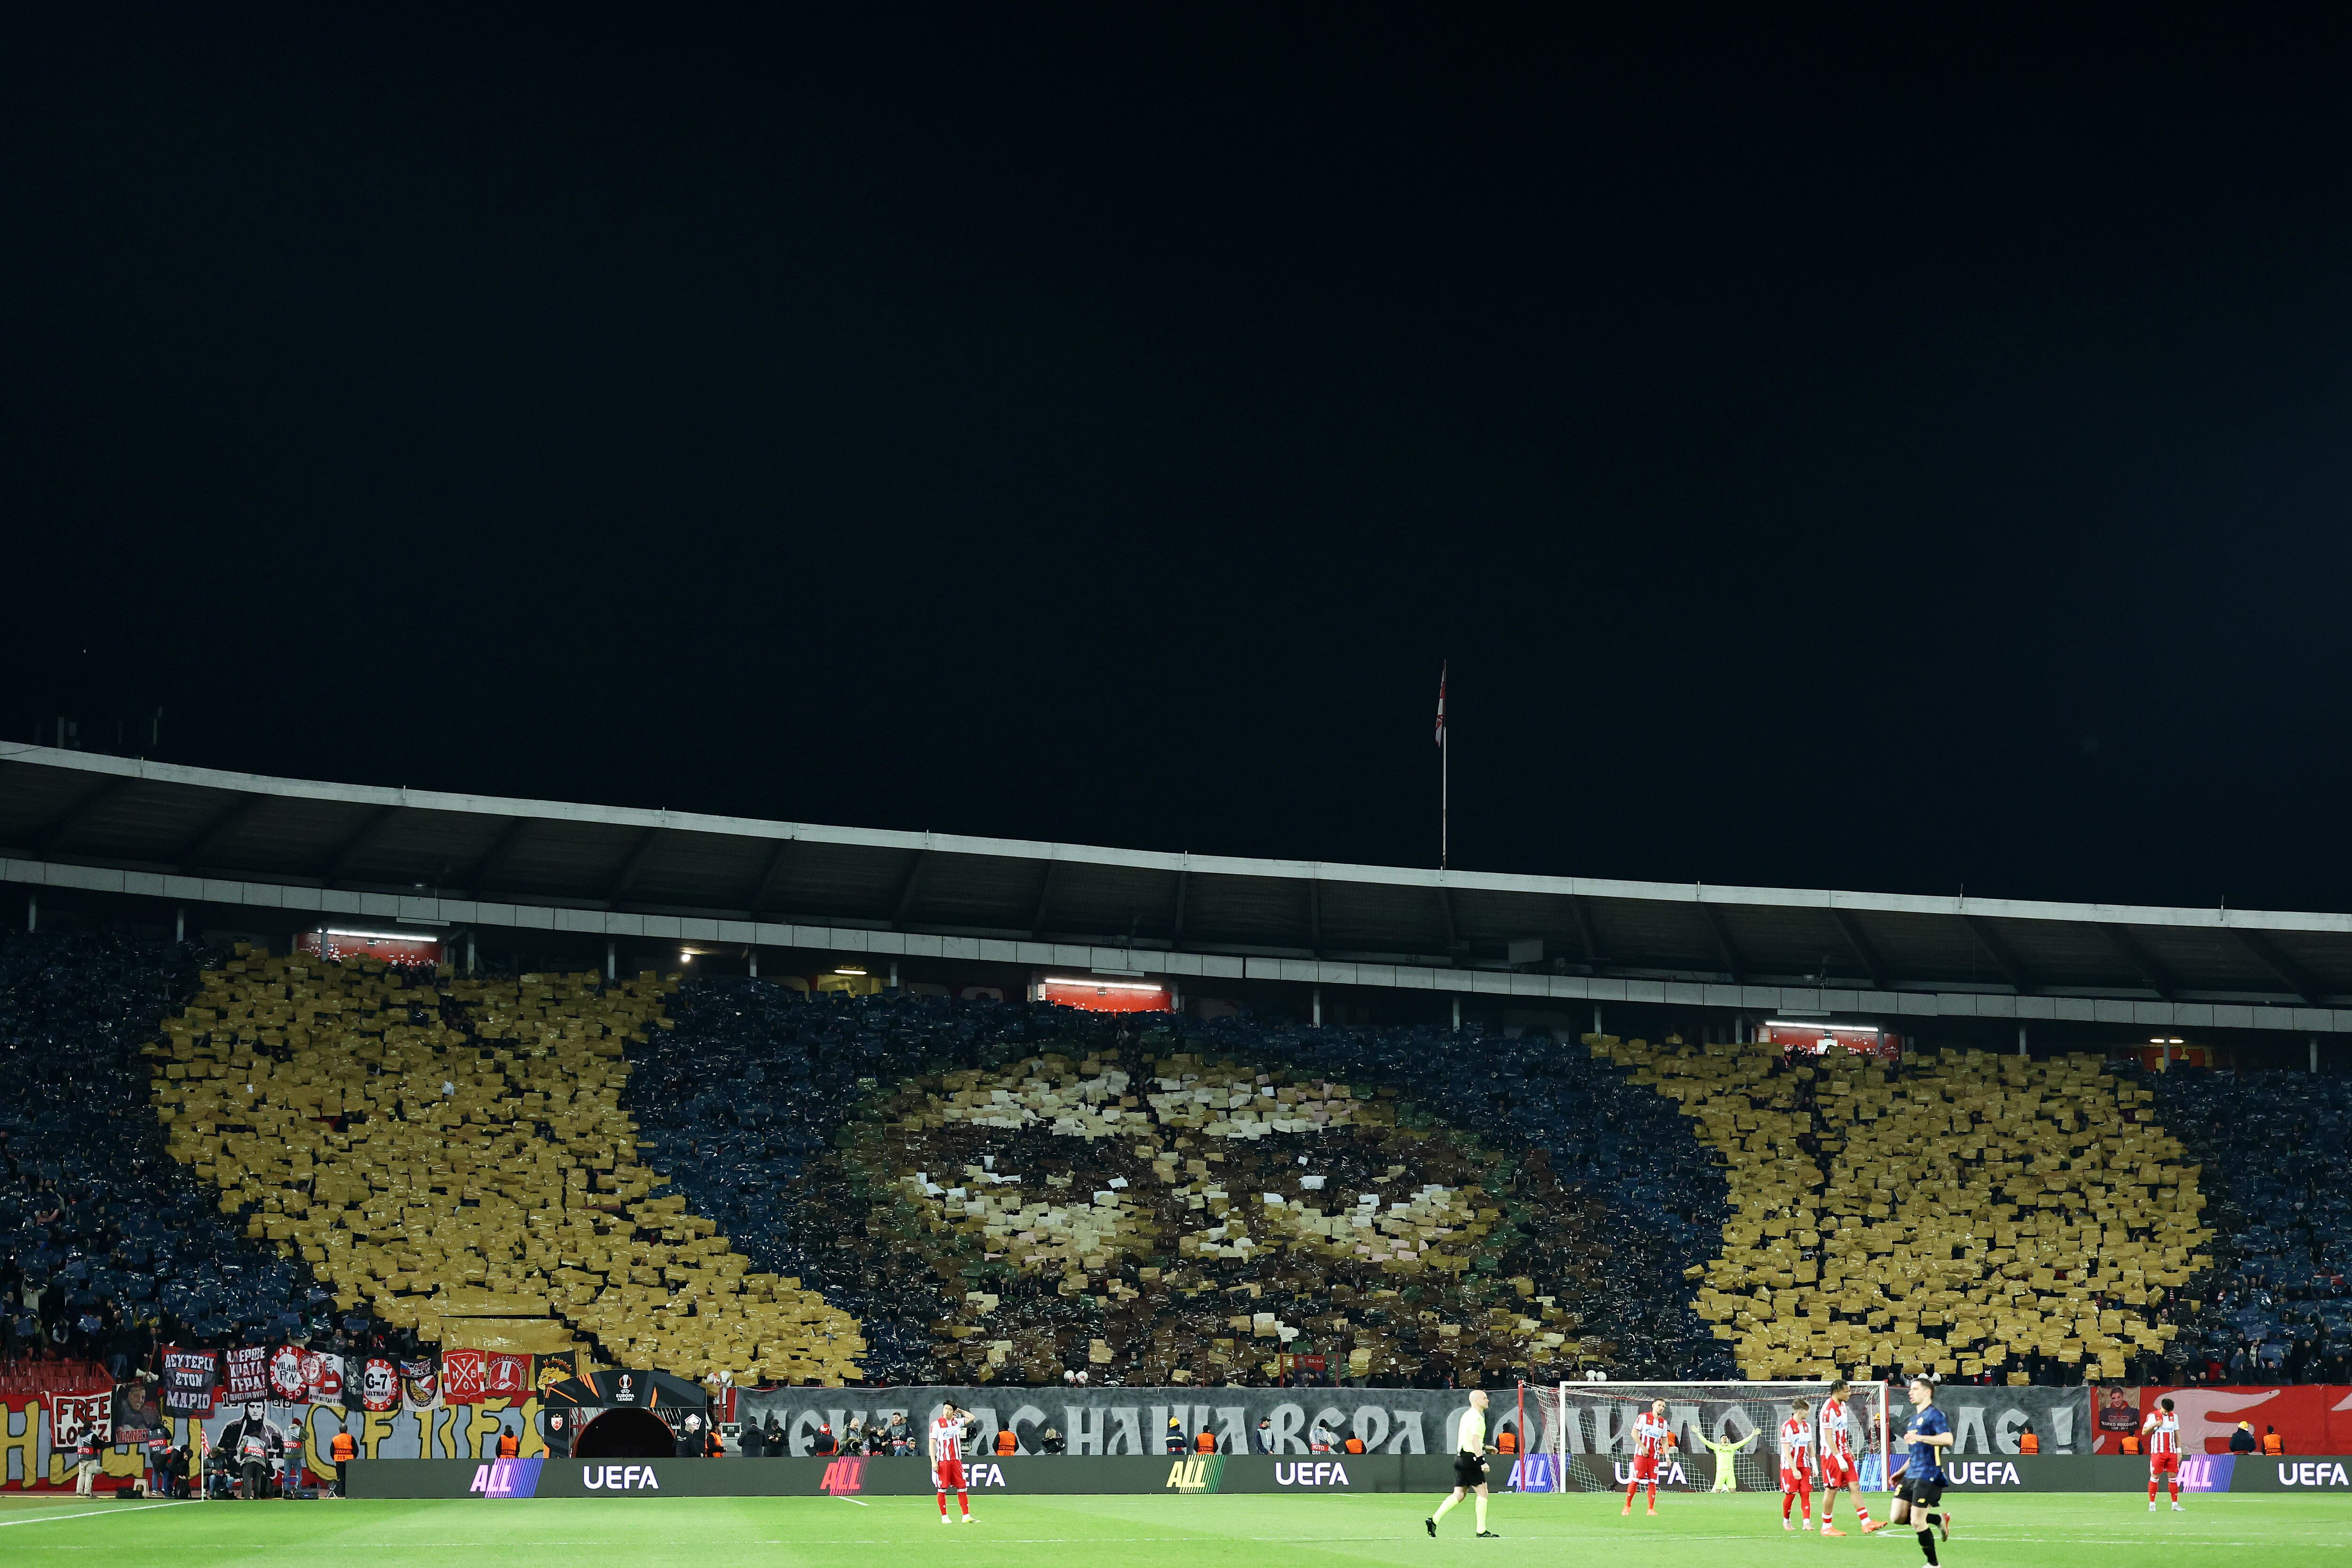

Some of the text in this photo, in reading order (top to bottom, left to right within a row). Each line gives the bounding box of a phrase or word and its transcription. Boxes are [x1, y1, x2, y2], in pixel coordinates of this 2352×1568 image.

[489, 1355, 525, 1369] IMPERIOSUS
[175, 1371, 203, 1387] ΣΤΟΝ
[365, 1373, 388, 1390] G-7
[166, 1391, 211, 1409] ΜΑΡΙΟ
[56, 1396, 110, 1424] FREE
[57, 1424, 109, 1444] LOZ
[470, 1465, 511, 1492] ALL
[583, 1465, 659, 1489] UEFA
[820, 1463, 860, 1490] ALL
[1166, 1461, 1206, 1488] ALL
[1275, 1462, 1350, 1486] UEFA
[1507, 1460, 1546, 1487] ALL
[1614, 1461, 1688, 1485] UFA
[1948, 1461, 2021, 1485] UEFA
[2176, 1461, 2212, 1487] ALL
[2278, 1463, 2350, 1486] UEFA
